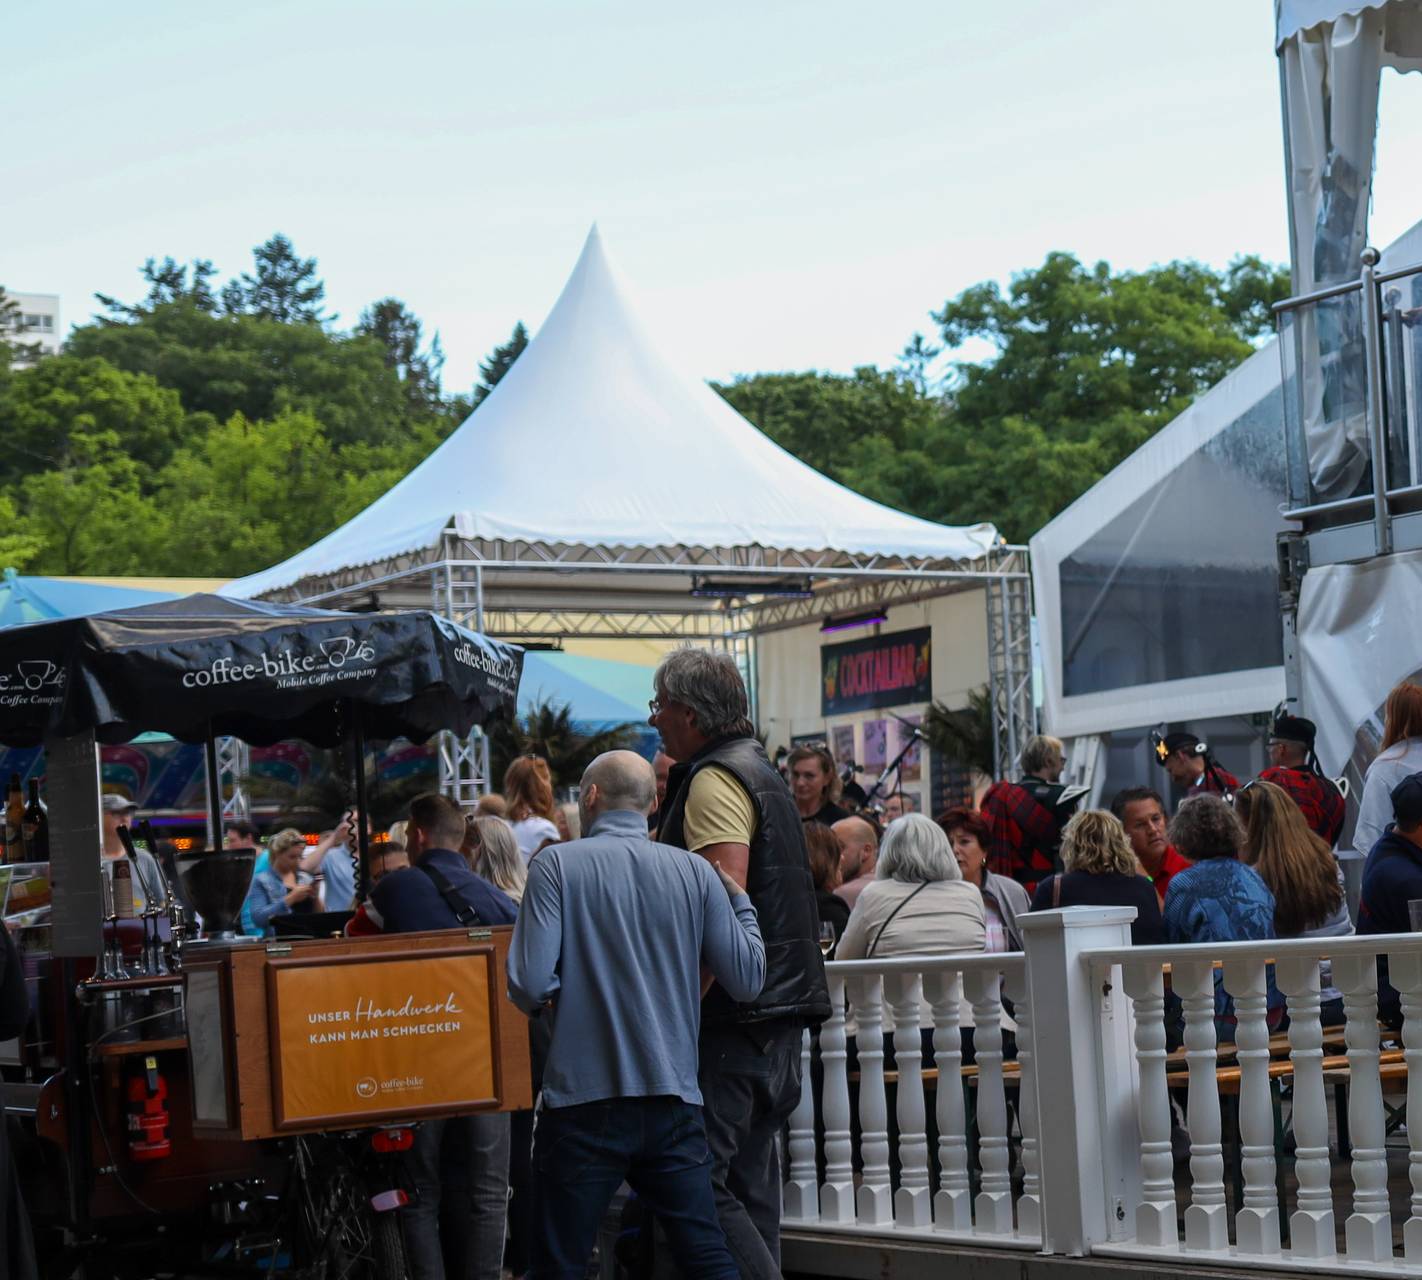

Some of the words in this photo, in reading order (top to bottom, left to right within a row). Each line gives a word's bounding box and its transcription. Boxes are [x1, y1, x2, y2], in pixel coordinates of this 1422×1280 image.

[182, 649, 315, 688] coffee-bike
[276, 676, 307, 689] Mobile
[308, 672, 335, 686] Coffee
[336, 667, 377, 681] Company
[840, 643, 916, 698] COCKTAILBAR
[308, 1011, 351, 1024] UNSER
[355, 992, 465, 1023] Handwerk
[309, 1031, 346, 1044] KANN
[350, 1028, 379, 1041] MAN
[383, 1021, 461, 1037] SCHMECKEN
